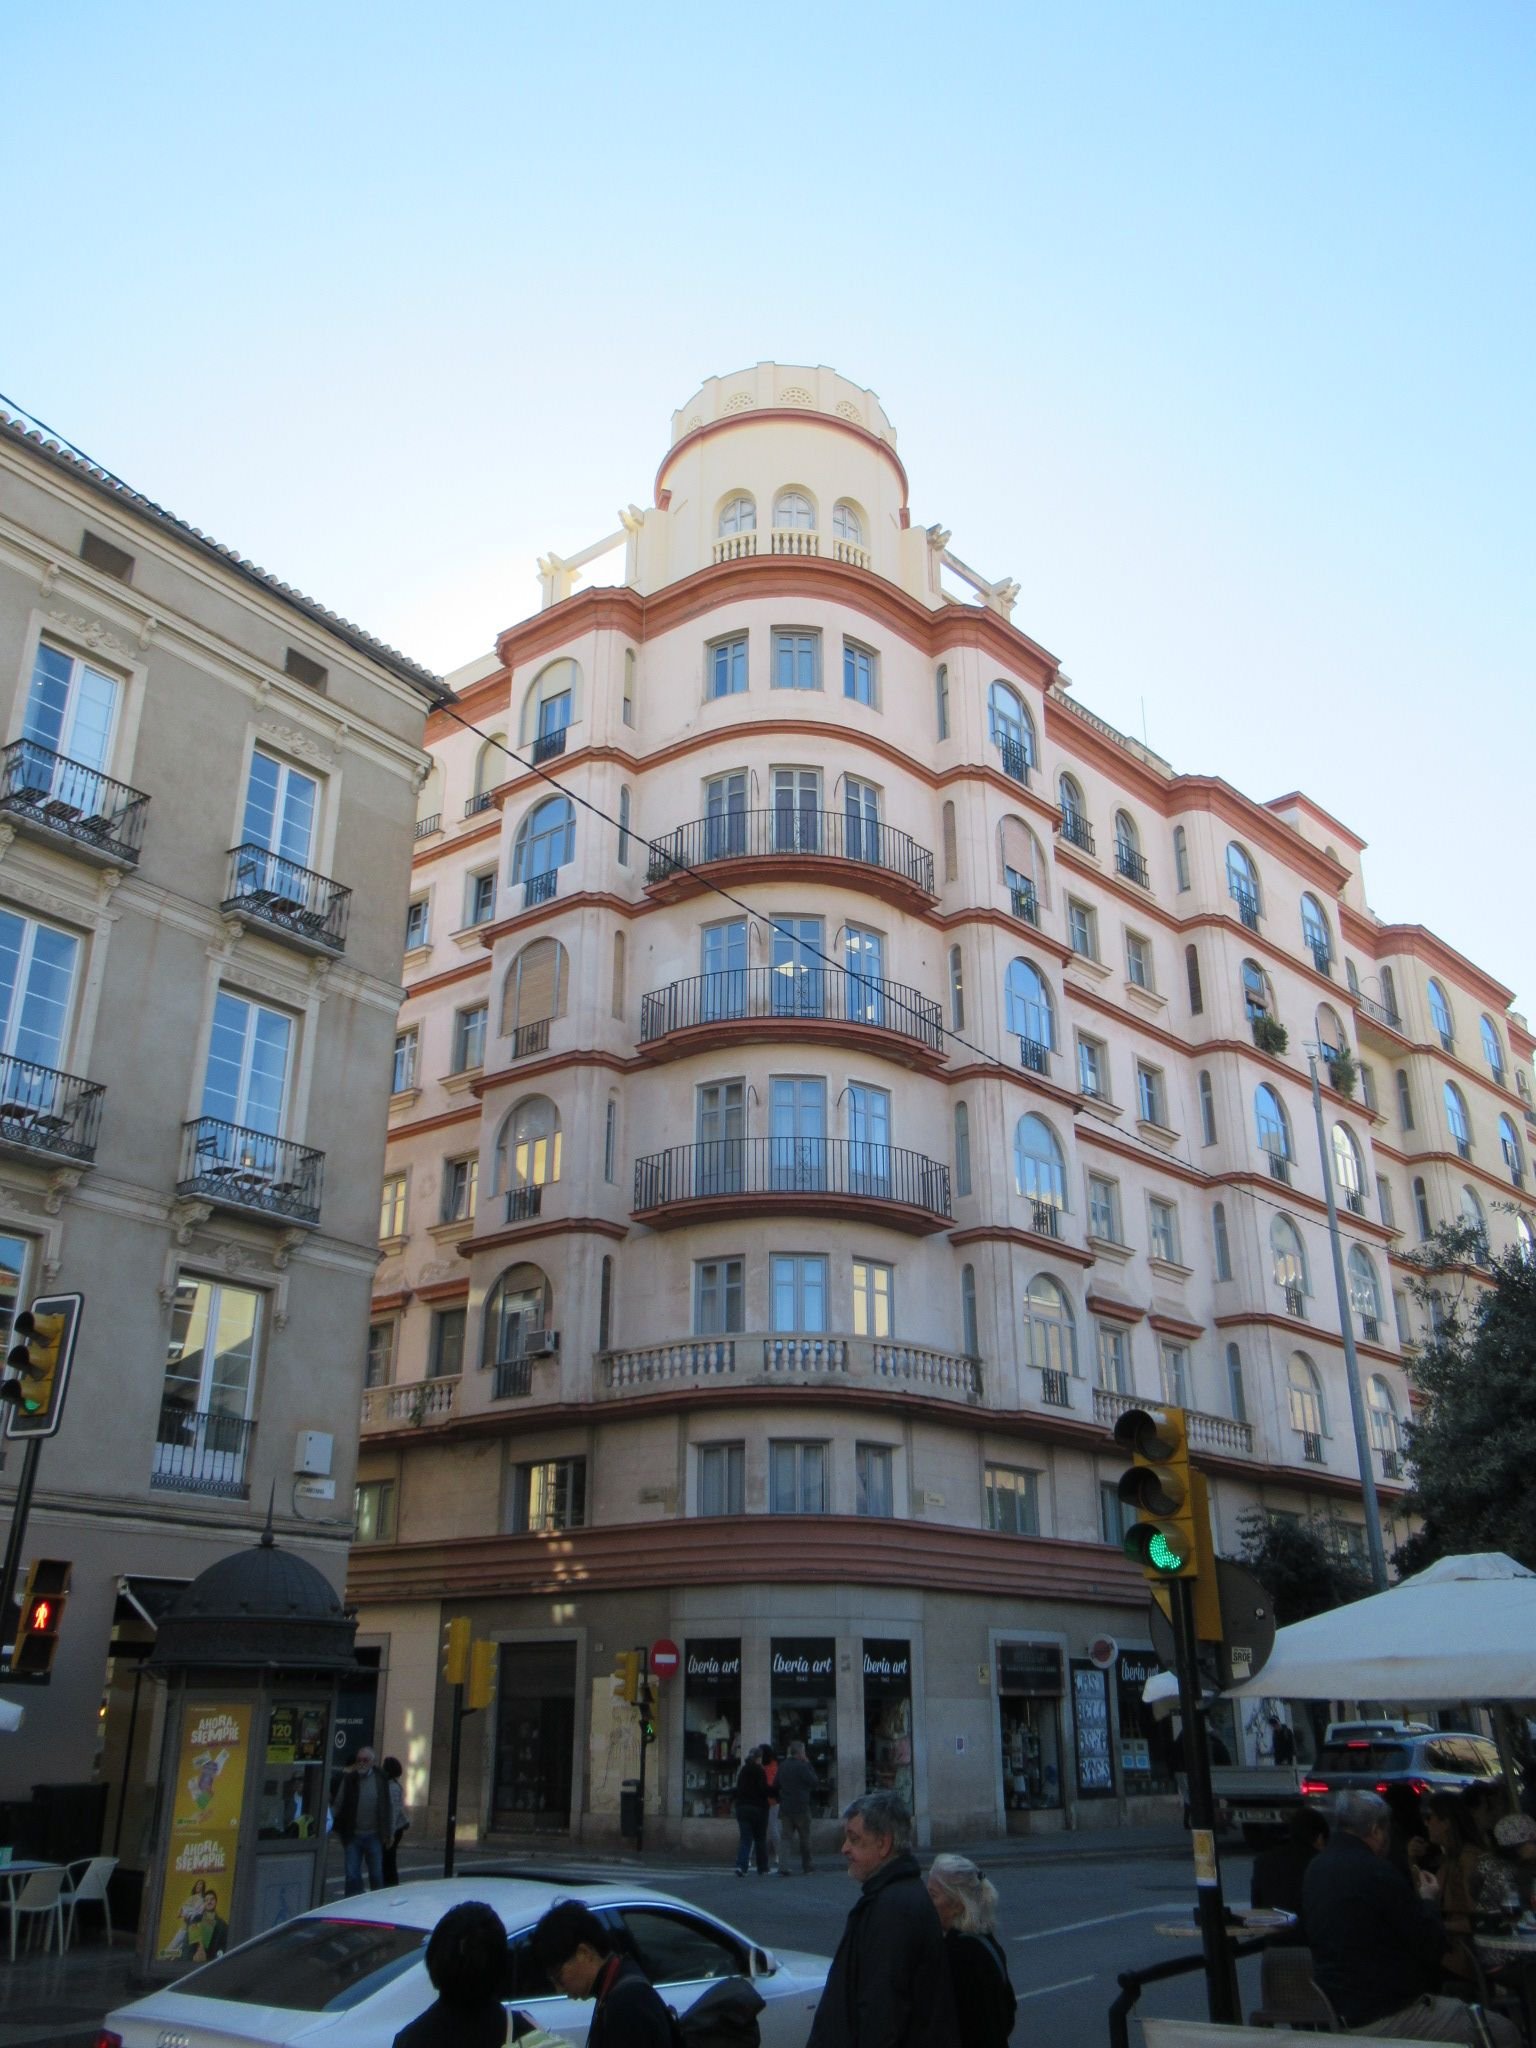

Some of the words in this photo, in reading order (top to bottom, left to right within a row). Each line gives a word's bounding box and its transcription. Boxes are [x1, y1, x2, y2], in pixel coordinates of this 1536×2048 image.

[722, 1658, 740, 1673] art
[812, 1656, 832, 1673] art
[892, 1658, 908, 1674] art
[198, 1715, 233, 1730] AHORA
[191, 1727, 239, 1745] SIEMPRE
[272, 1724, 292, 1738] 120
[183, 1840, 219, 1857] AHORA
[176, 1852, 225, 1873] SIEMPRE
